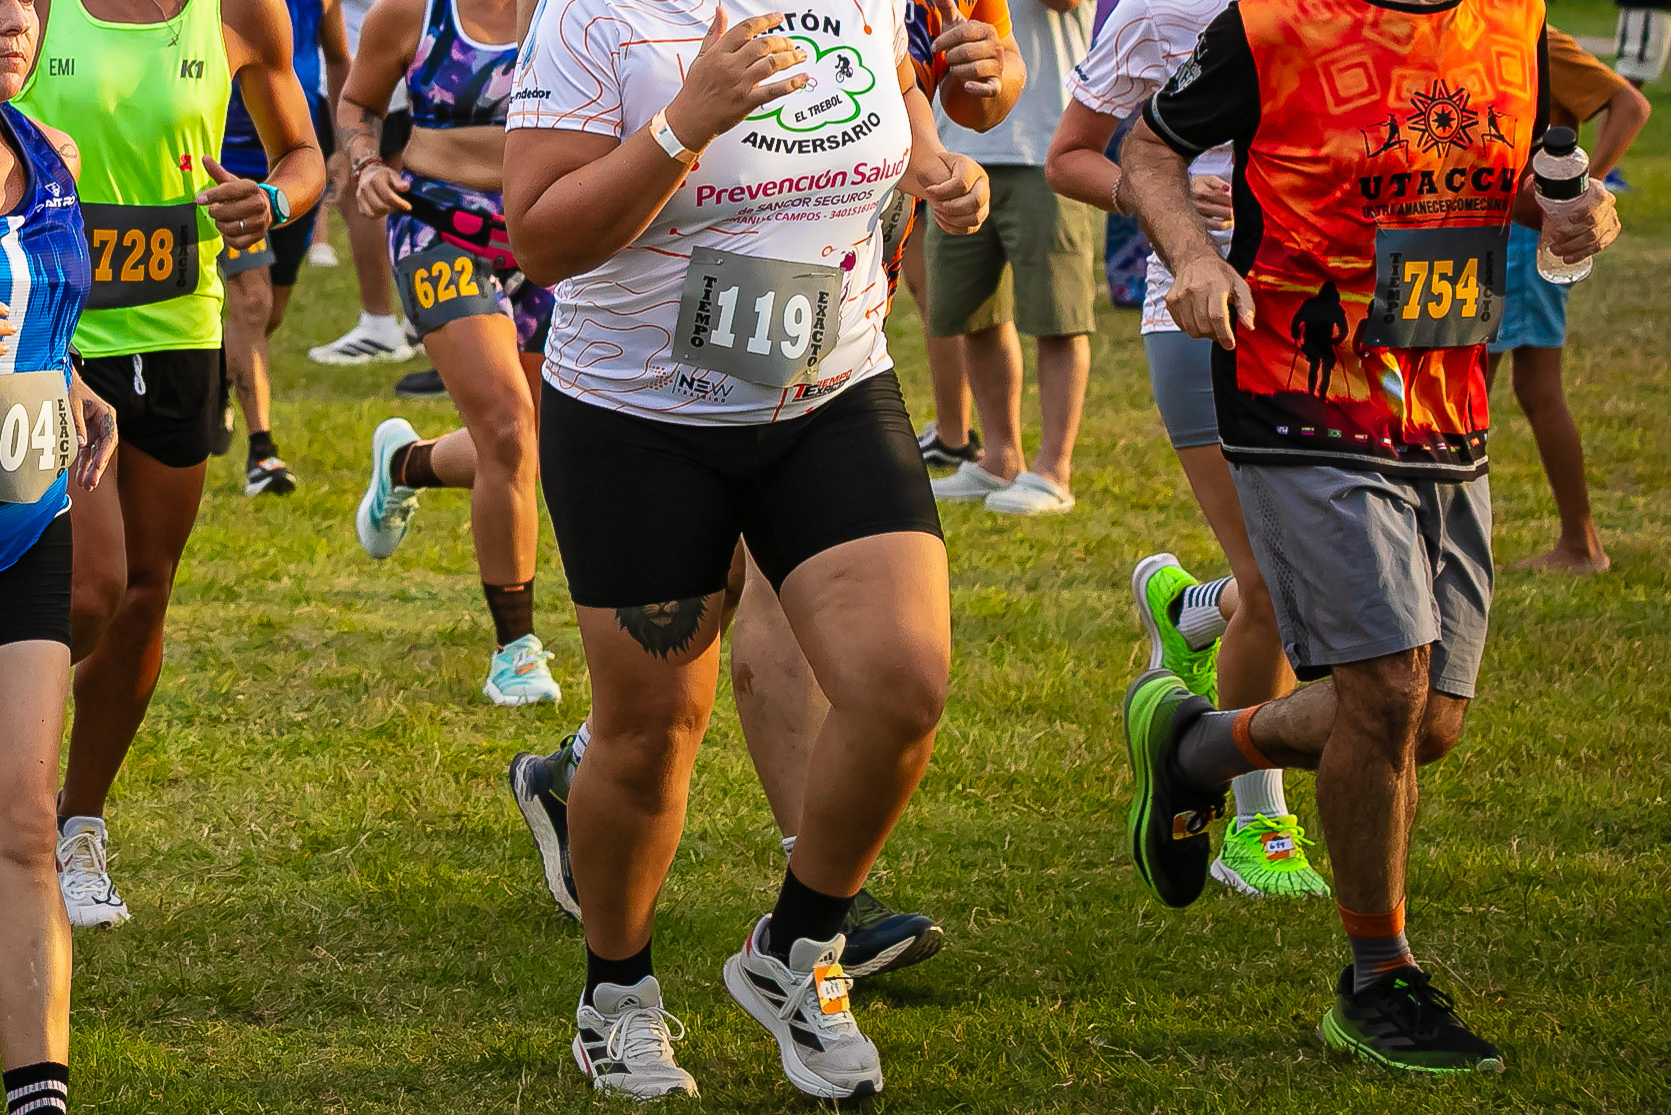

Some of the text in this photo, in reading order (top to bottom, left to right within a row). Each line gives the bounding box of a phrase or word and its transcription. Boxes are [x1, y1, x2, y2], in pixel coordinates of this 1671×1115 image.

[49, 58, 75, 76] EMI
[180, 60, 204, 78] K1
[794, 94, 843, 123] EL TREBOL
[741, 112, 881, 154] ANIVERSARIO
[696, 170, 847, 207] Prevención
[756, 197, 811, 212] SANCOR
[813, 189, 874, 207] SEGUROS
[775, 211, 821, 222] CAMPOS
[93, 228, 174, 282] 728
[414, 256, 479, 309] 622
[1384, 252, 1402, 324] TIEMPO
[1402, 258, 1479, 320] 754
[690, 275, 717, 348] TIEMPO
[710, 286, 813, 360] 119
[807, 291, 829, 367] EXACTO
[679, 373, 735, 398] NEW
